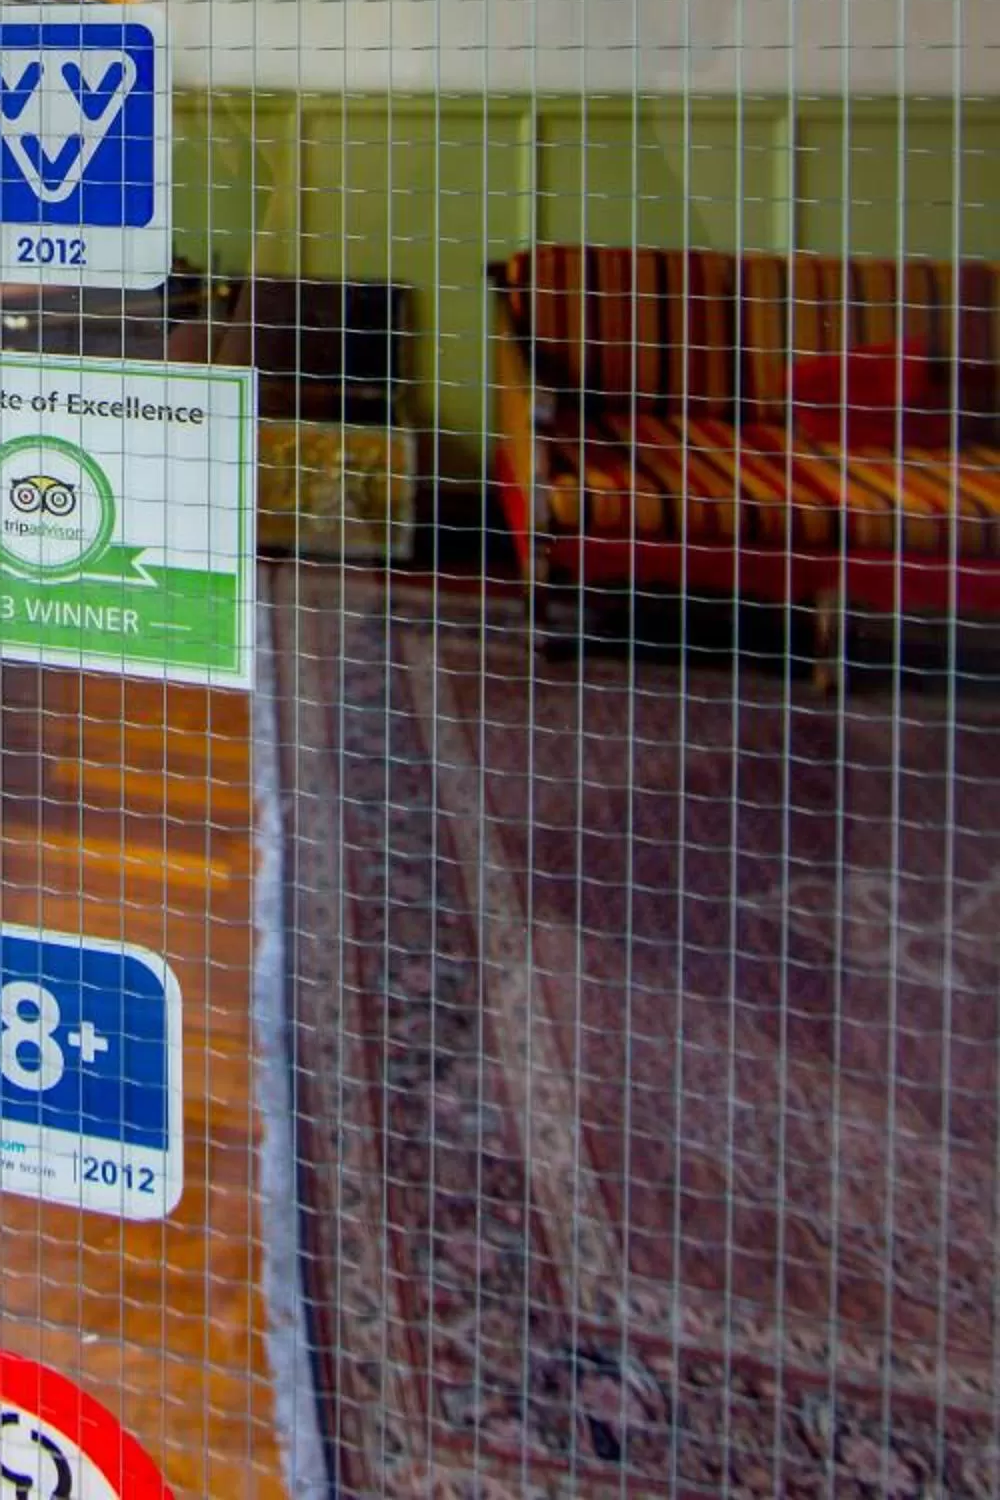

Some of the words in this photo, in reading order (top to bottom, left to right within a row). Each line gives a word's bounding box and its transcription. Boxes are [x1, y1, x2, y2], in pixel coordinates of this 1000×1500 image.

[17, 236, 87, 265] 2012
[31, 391, 59, 413] of
[67, 393, 205, 425] Excellence
[25, 597, 140, 635] WINNER
[84, 1155, 156, 1194] 2012
